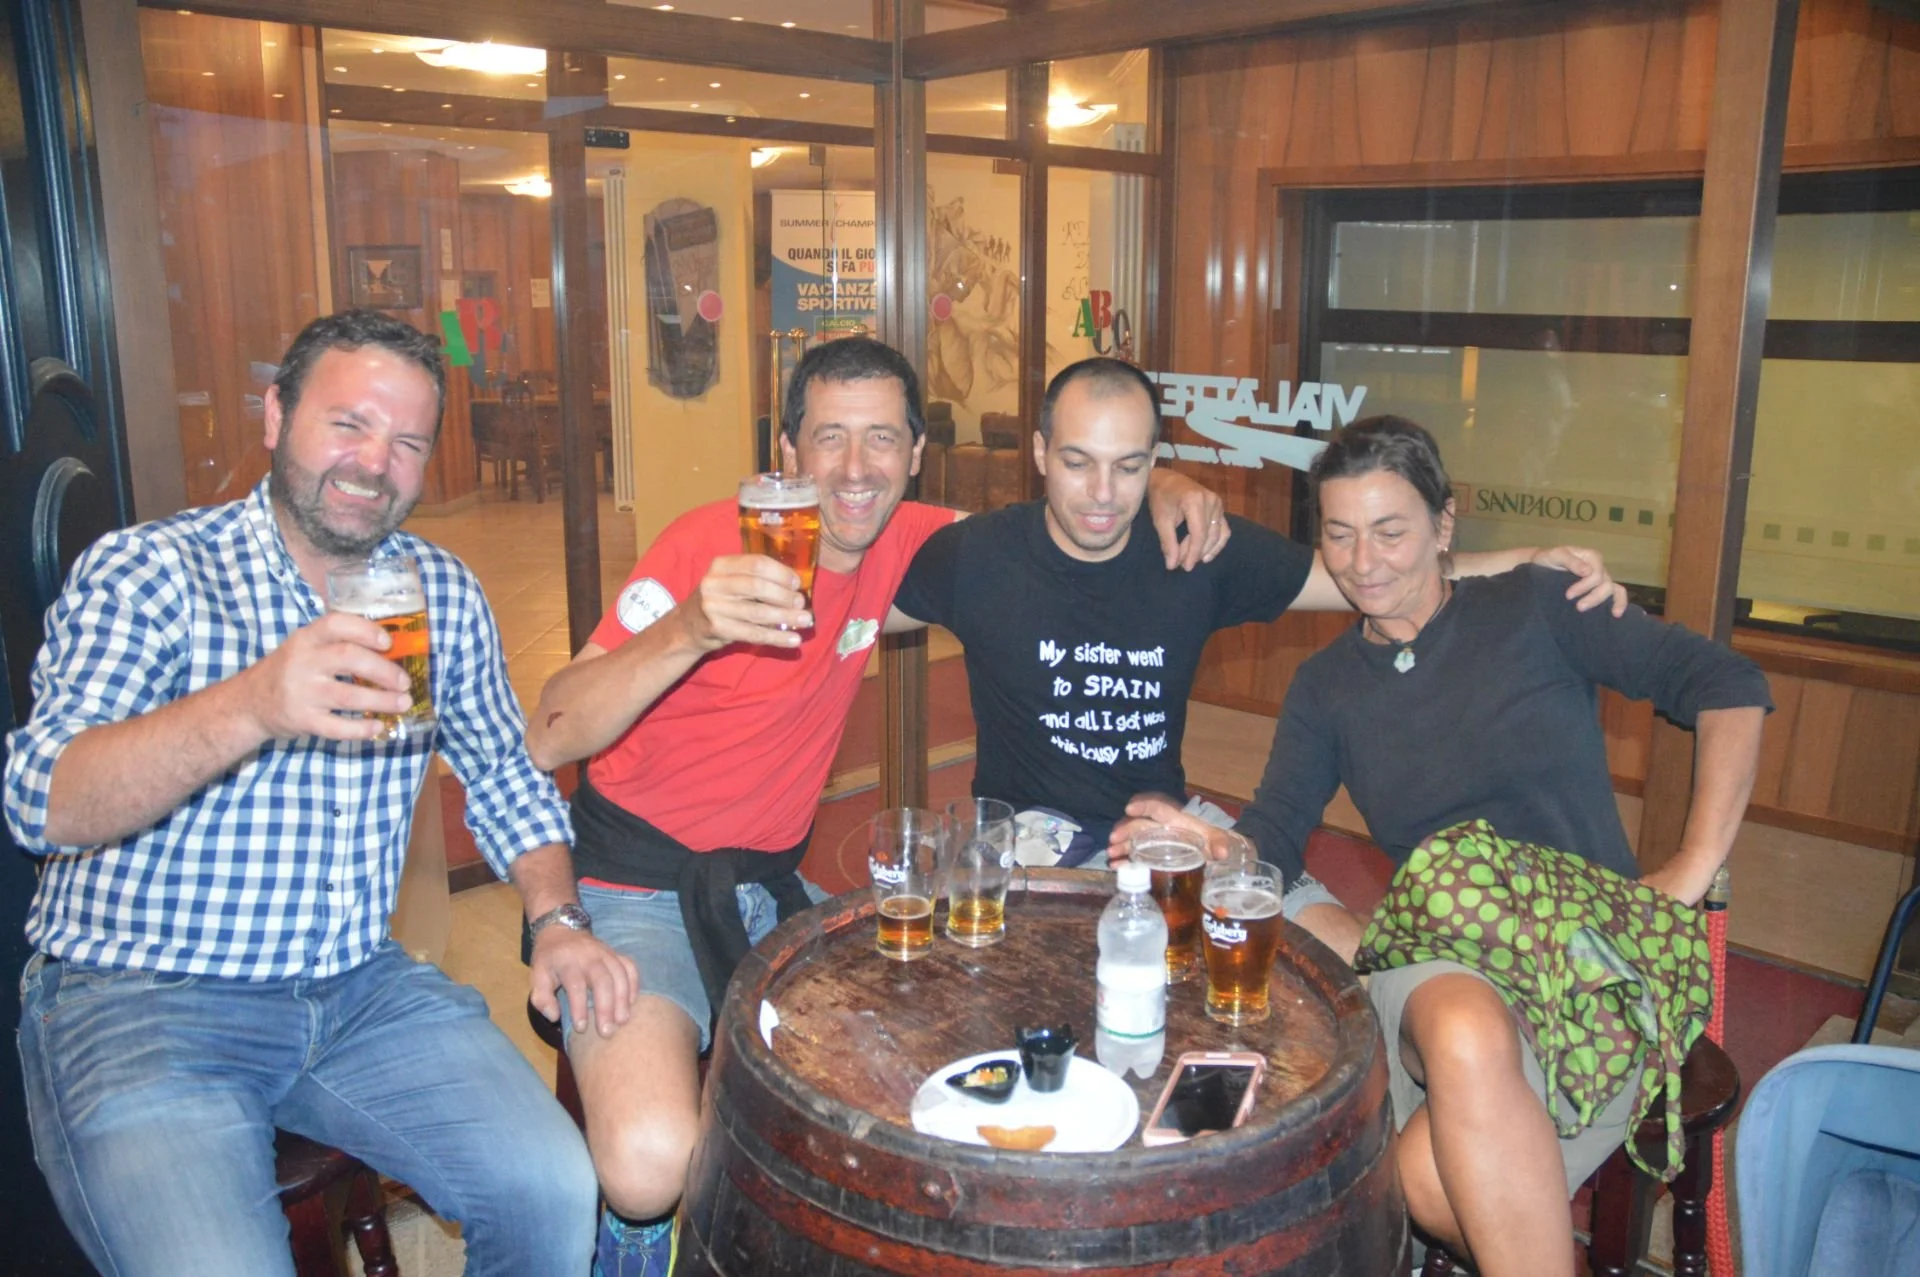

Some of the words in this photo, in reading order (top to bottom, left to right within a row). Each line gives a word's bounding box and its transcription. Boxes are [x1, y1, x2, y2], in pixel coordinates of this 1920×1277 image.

[779, 218, 830, 228] SUMMER
[788, 248, 838, 260] QUANDO
[842, 248, 852, 260] IL
[841, 261, 856, 273] FA
[1475, 488, 1598, 523] SANPAOLO
[1039, 639, 1067, 667] My
[1074, 642, 1122, 665] sister
[1126, 646, 1165, 667] went
[1053, 676, 1072, 697] to
[1083, 674, 1161, 699] SPAIN
[1074, 709, 1099, 731] all
[1101, 711, 1113, 731] I
[1115, 710, 1141, 732] got
[1080, 742, 1120, 765] lousy
